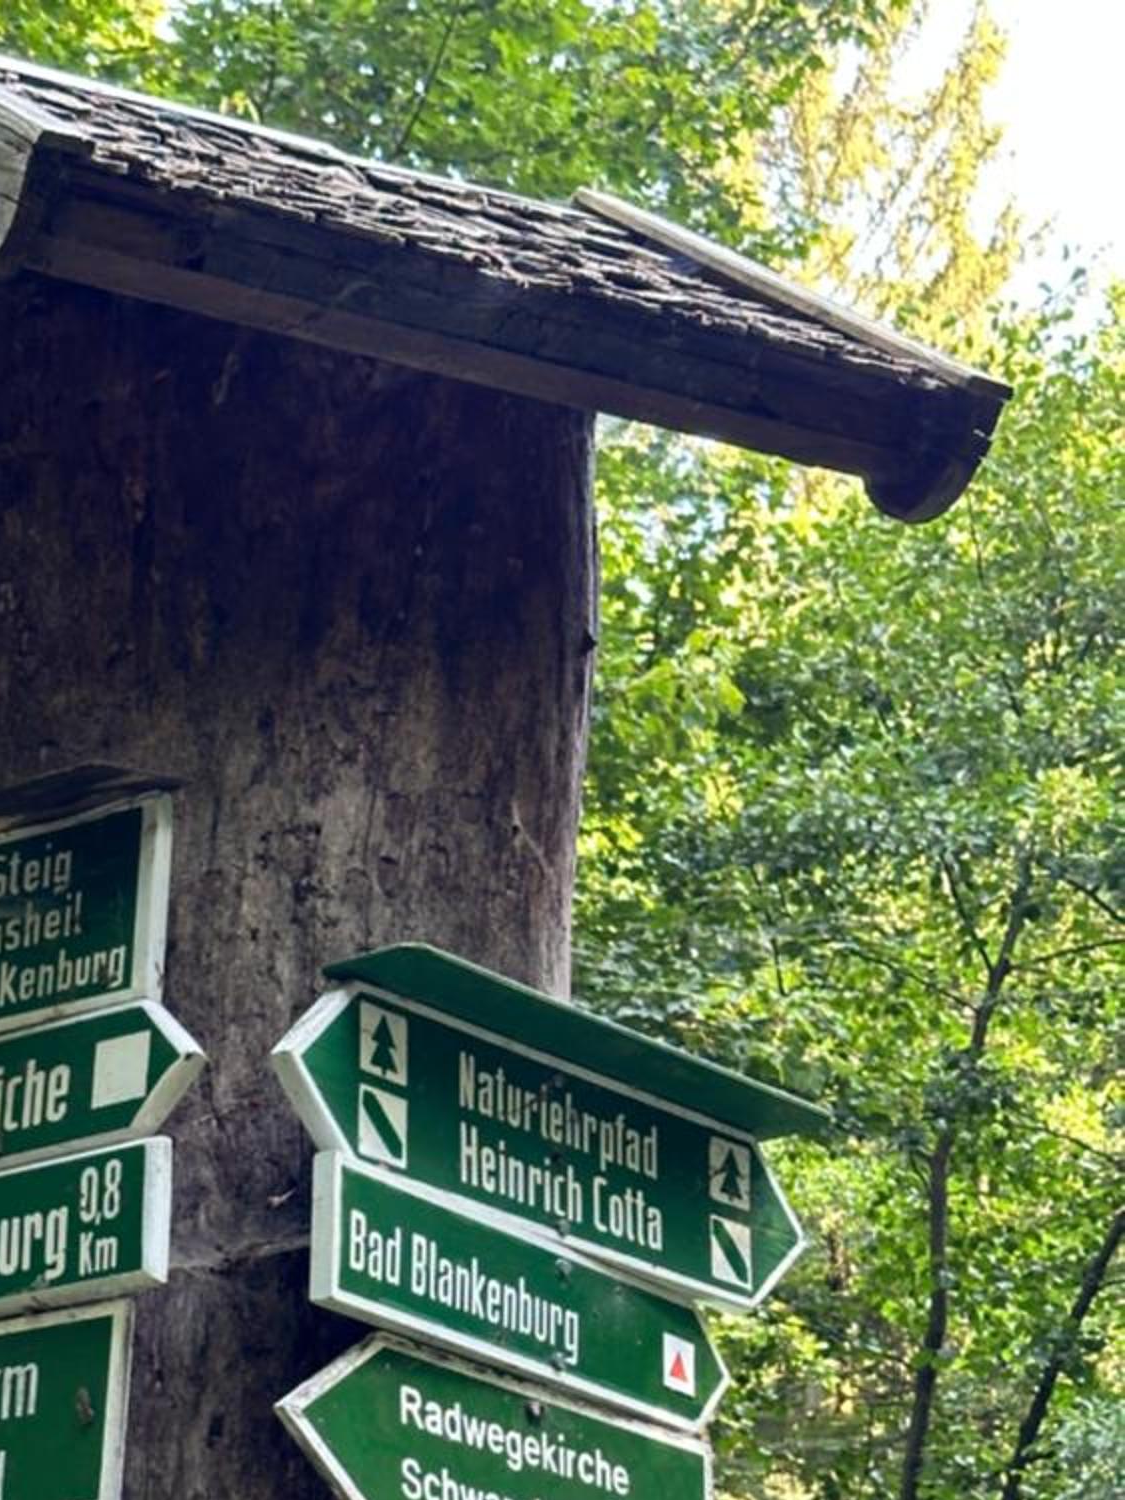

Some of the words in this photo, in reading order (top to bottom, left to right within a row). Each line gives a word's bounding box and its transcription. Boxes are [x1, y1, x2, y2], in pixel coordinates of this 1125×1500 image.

[459, 1051, 659, 1181] Naturlehrpfad
[460, 1121, 583, 1224] Heinrich
[593, 1176, 663, 1251] Cotta
[349, 1208, 402, 1287] Bad
[411, 1232, 580, 1367] Blankenburg
[399, 1385, 630, 1496] Radwegekirche
